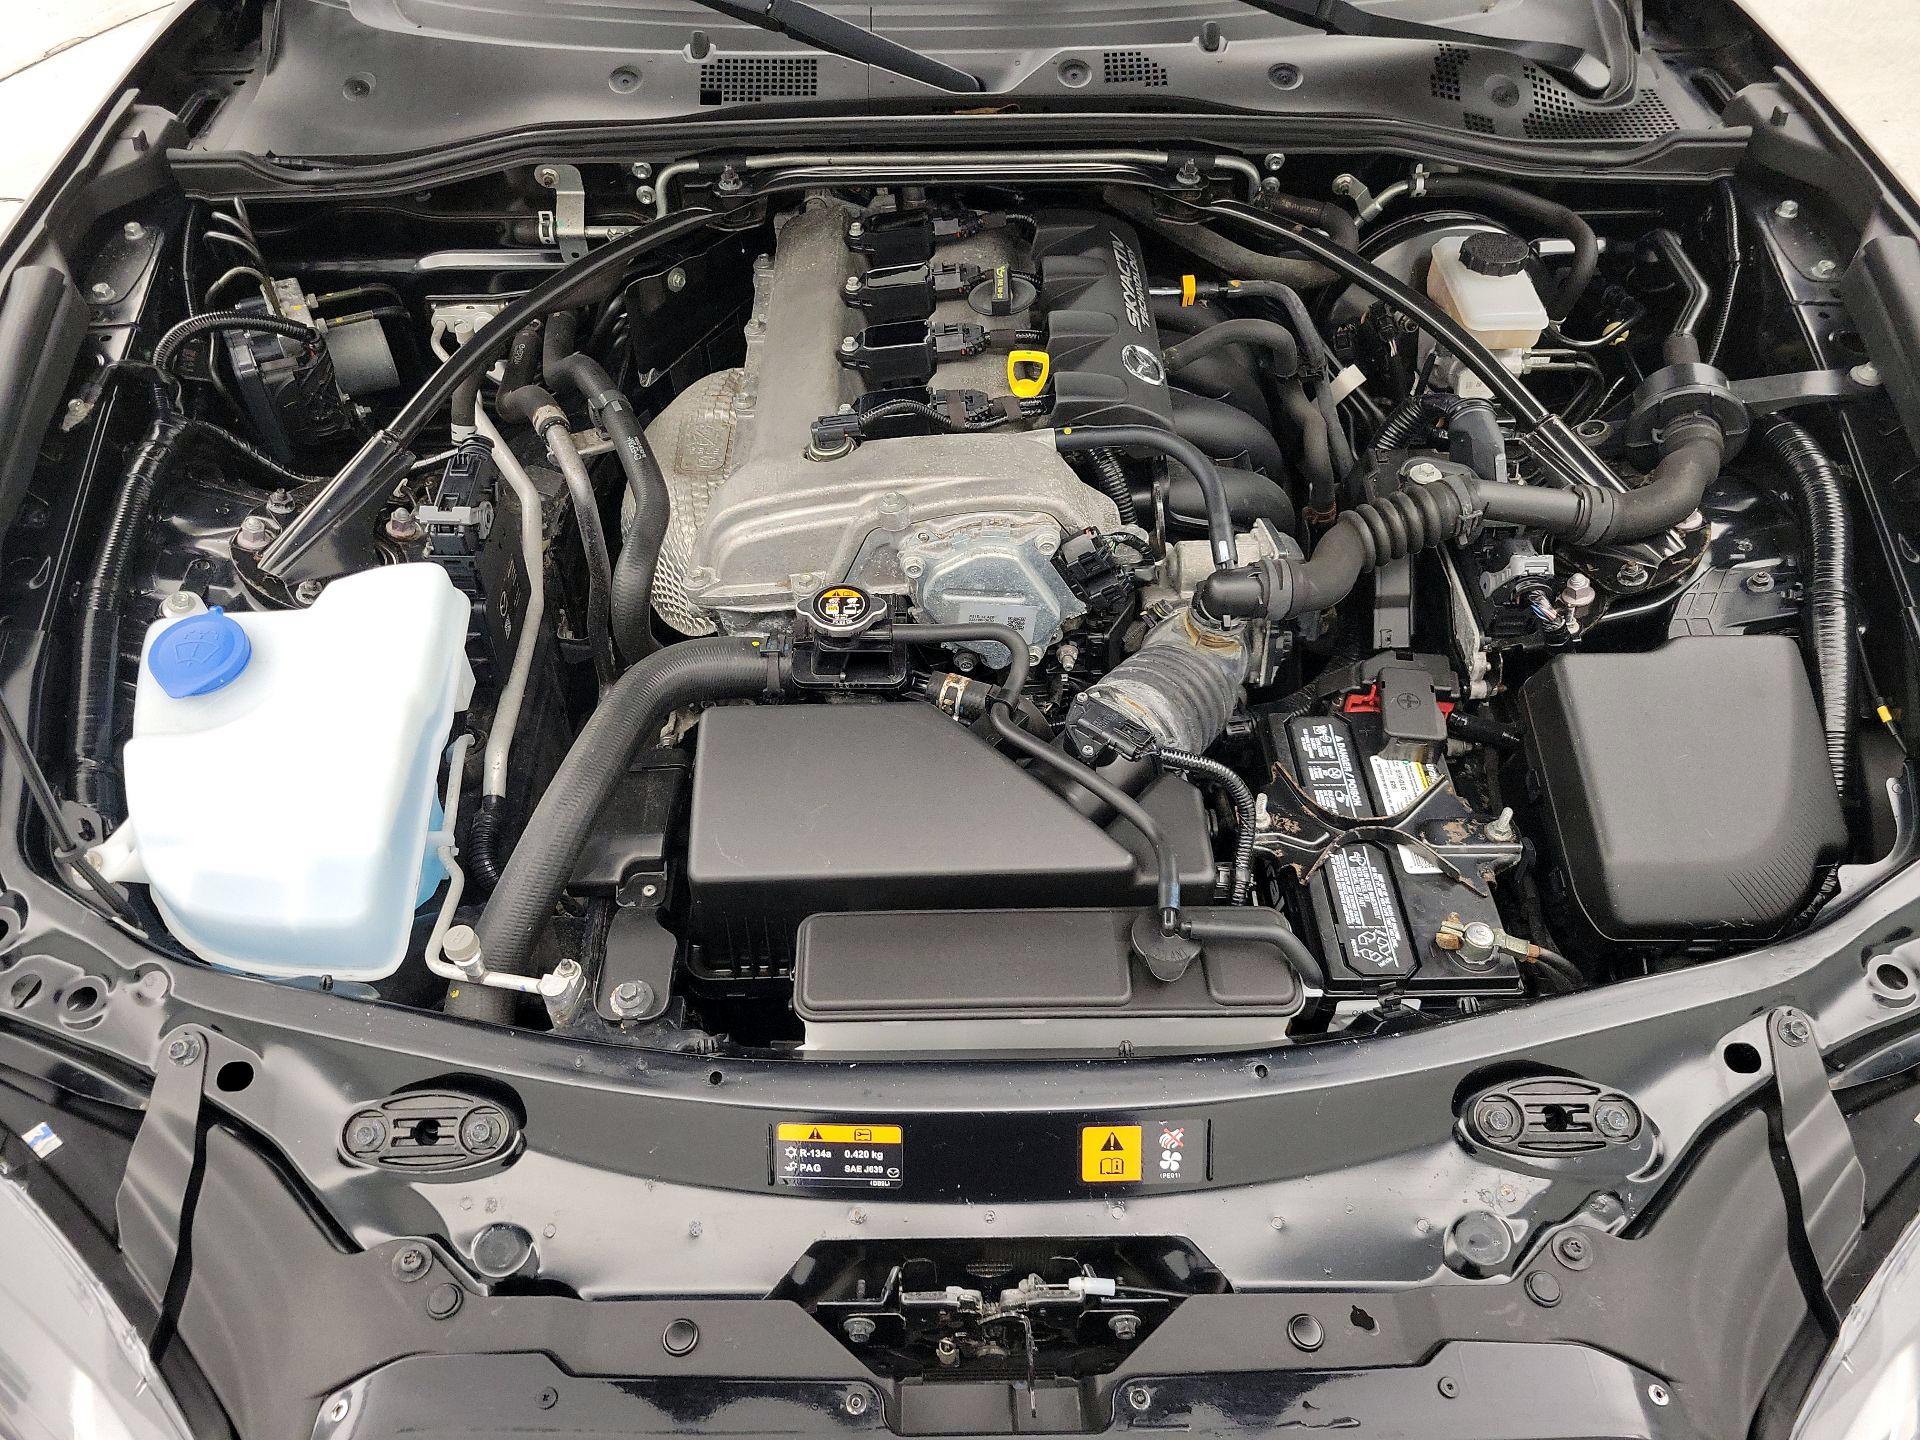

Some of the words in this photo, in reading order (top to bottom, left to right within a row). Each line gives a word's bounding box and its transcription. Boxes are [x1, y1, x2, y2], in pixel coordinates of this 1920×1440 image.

[1109, 230, 1142, 333] SKYACTIV
[1125, 244, 1151, 328] TECHNOLOGY
[799, 1148, 832, 1158] R-134a
[844, 1150, 870, 1159] 0.420
[871, 1150, 884, 1160] kg
[799, 1163, 822, 1172] PAG
[844, 1164, 863, 1173] SAE
[864, 1165, 884, 1173] J639
